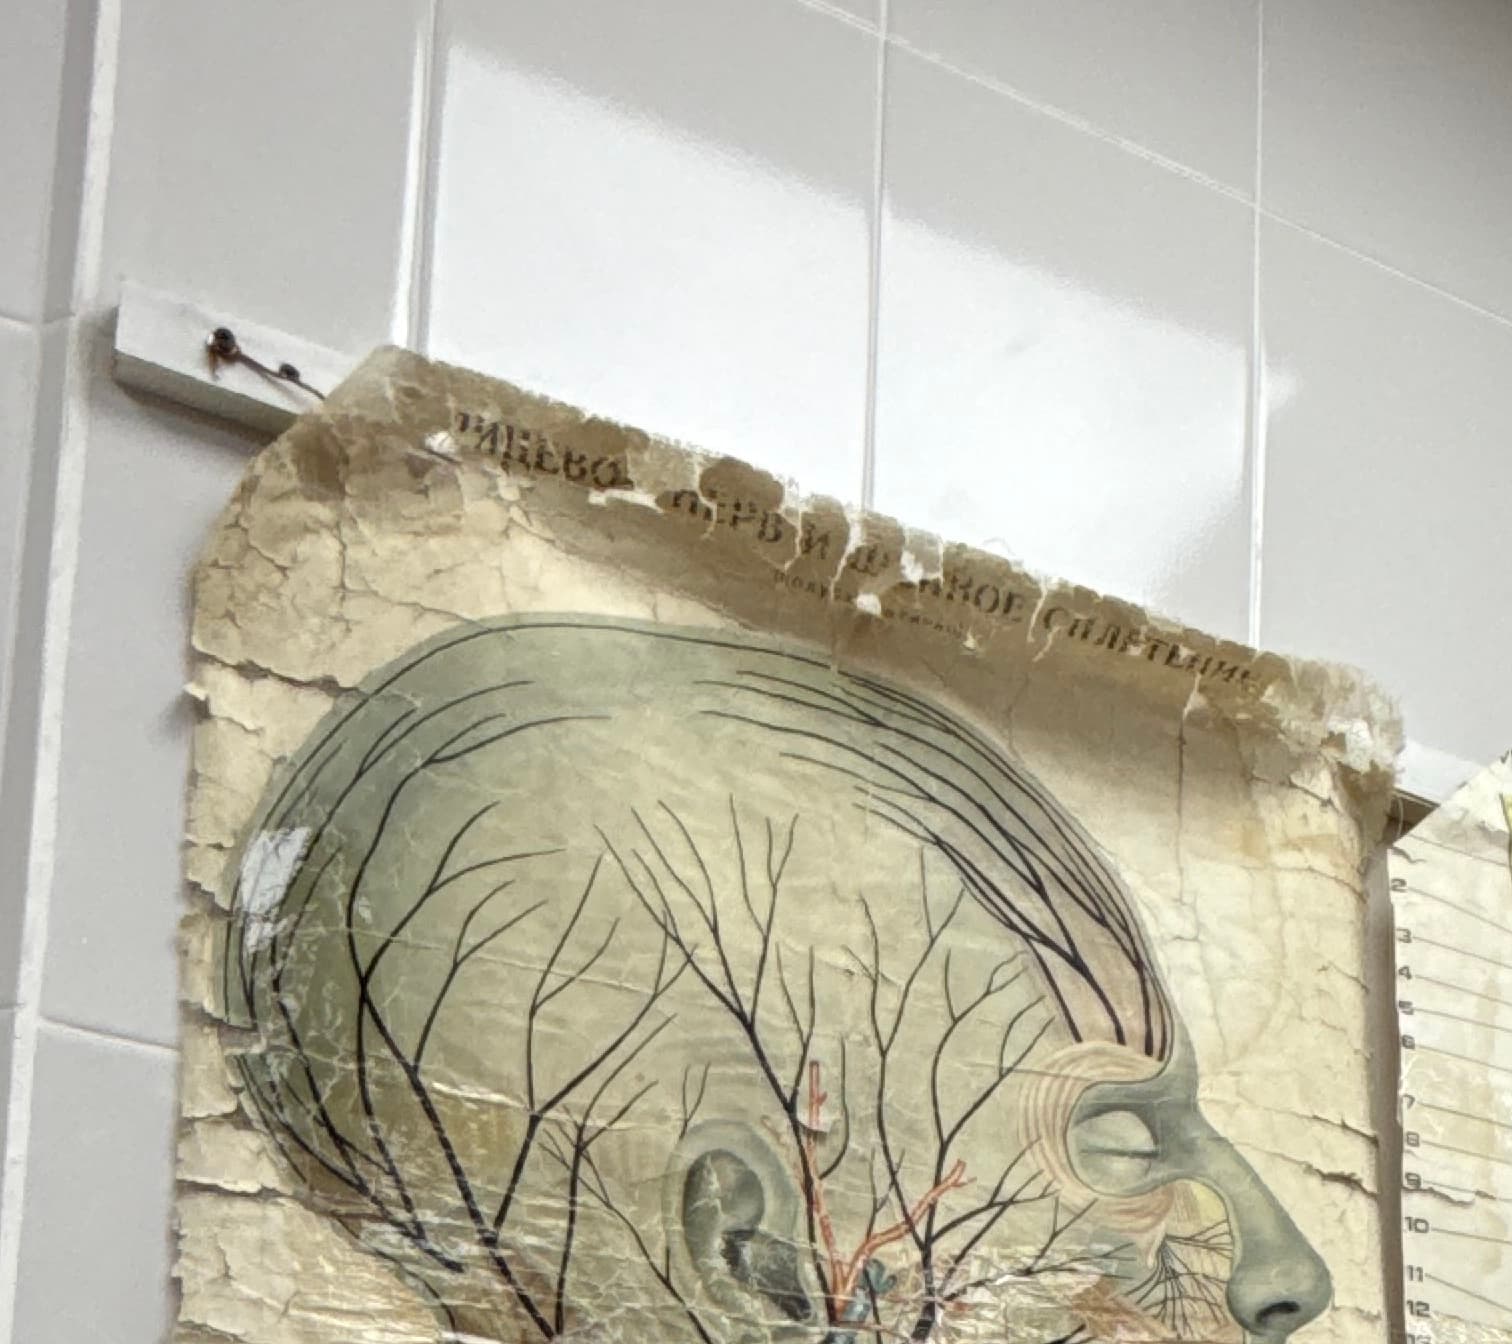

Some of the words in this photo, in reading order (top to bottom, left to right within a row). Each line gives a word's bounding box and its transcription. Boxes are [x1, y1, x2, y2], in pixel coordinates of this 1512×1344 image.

[1398, 965, 1412, 980] 4
[1405, 1132, 1420, 1147] 8
[1405, 1172, 1422, 1189] 9
[1405, 1217, 1430, 1234] 10
[1406, 1265, 1424, 1282] 11
[1406, 1300, 1431, 1317] 12
